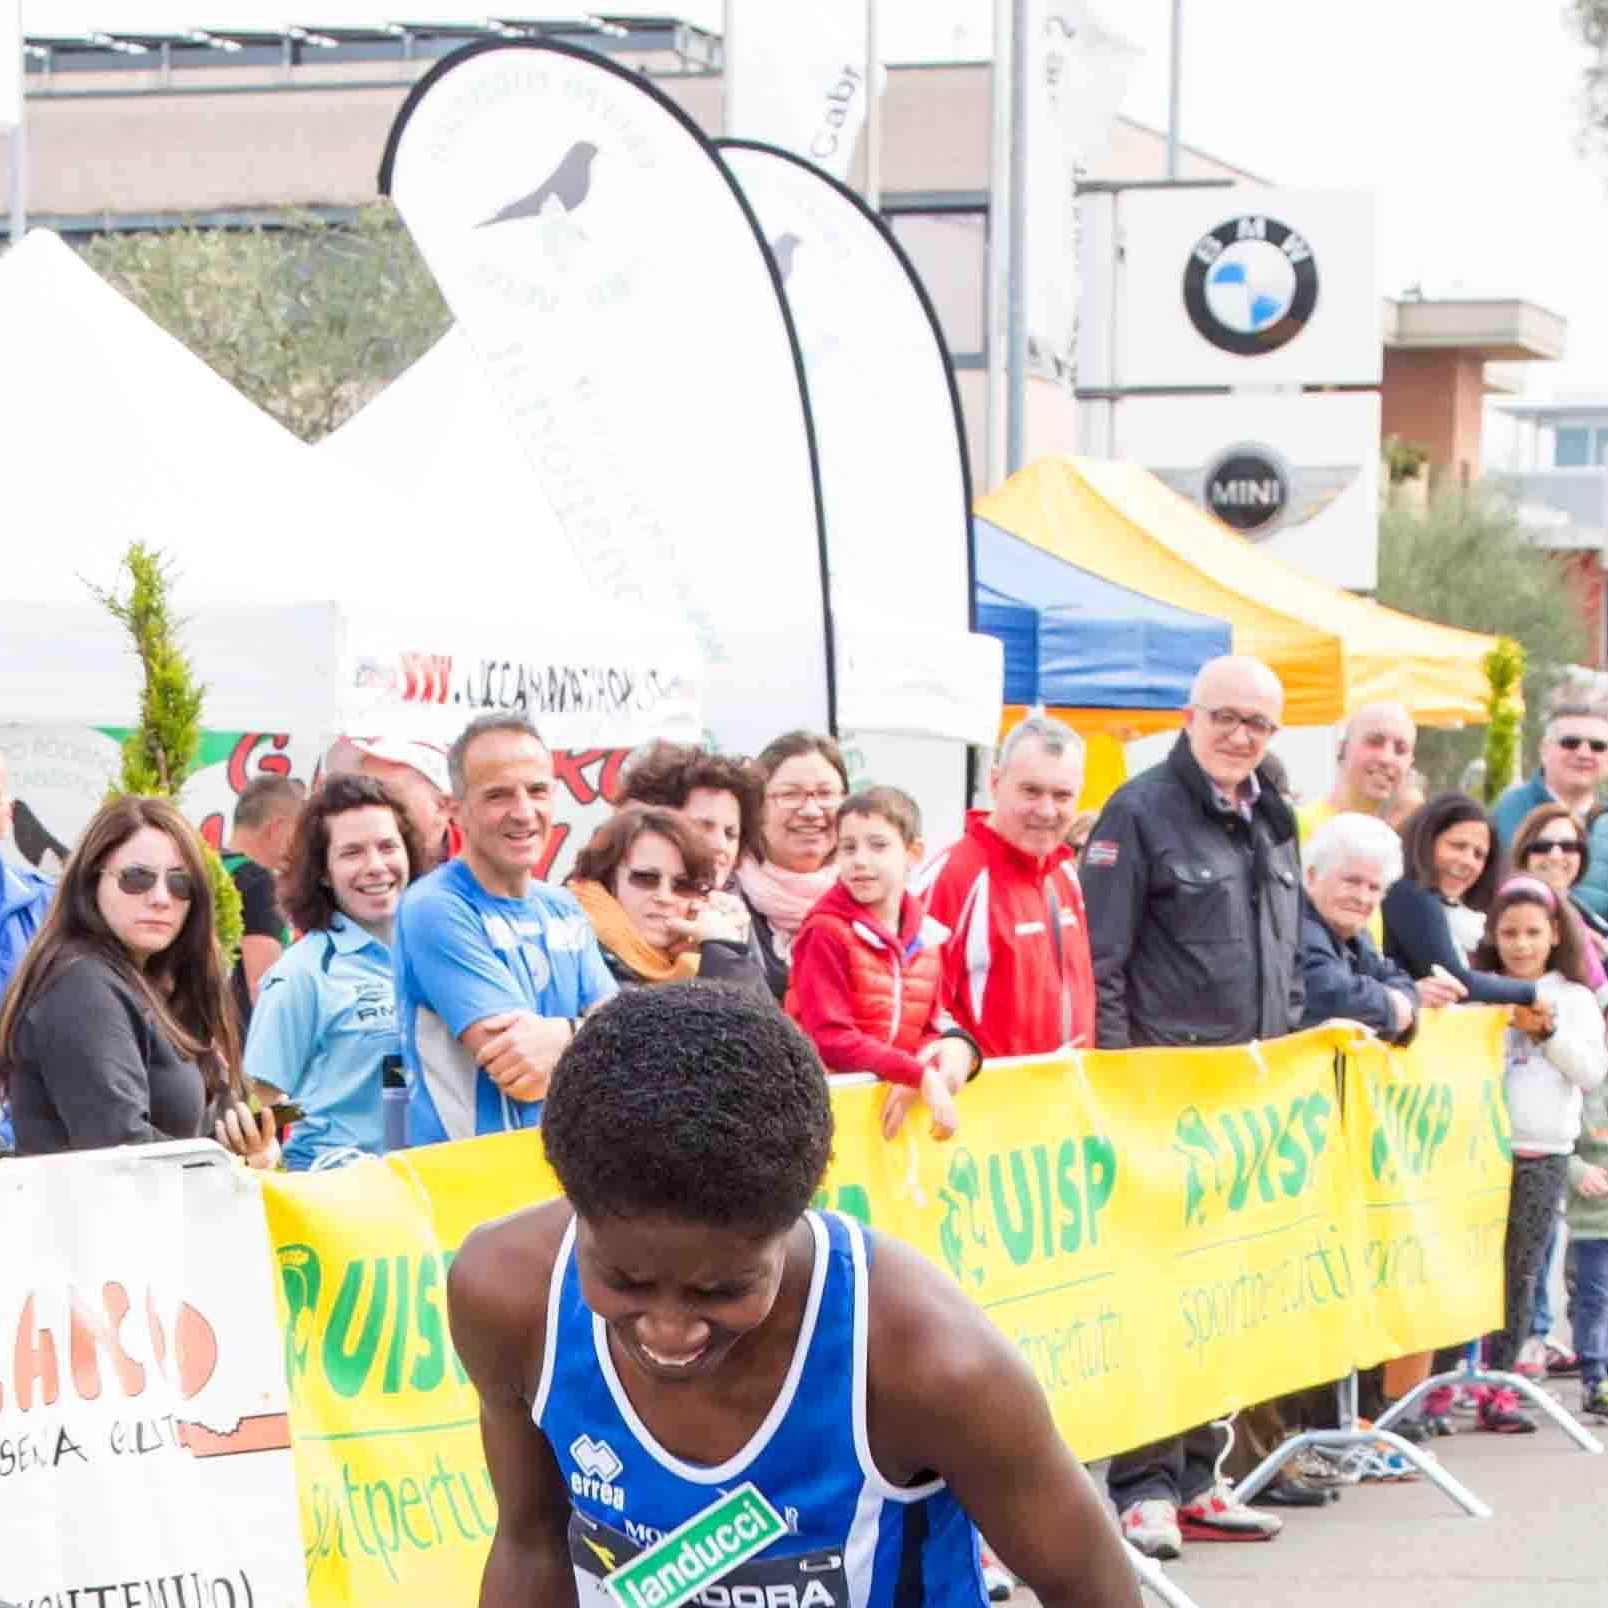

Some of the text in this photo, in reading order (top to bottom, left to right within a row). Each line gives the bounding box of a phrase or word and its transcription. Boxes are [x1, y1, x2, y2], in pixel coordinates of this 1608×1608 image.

[1195, 215, 1312, 264] BMW
[1211, 478, 1283, 508] MINI
[1221, 1090, 1333, 1212] UISP
[989, 1135, 1117, 1266] UISP
